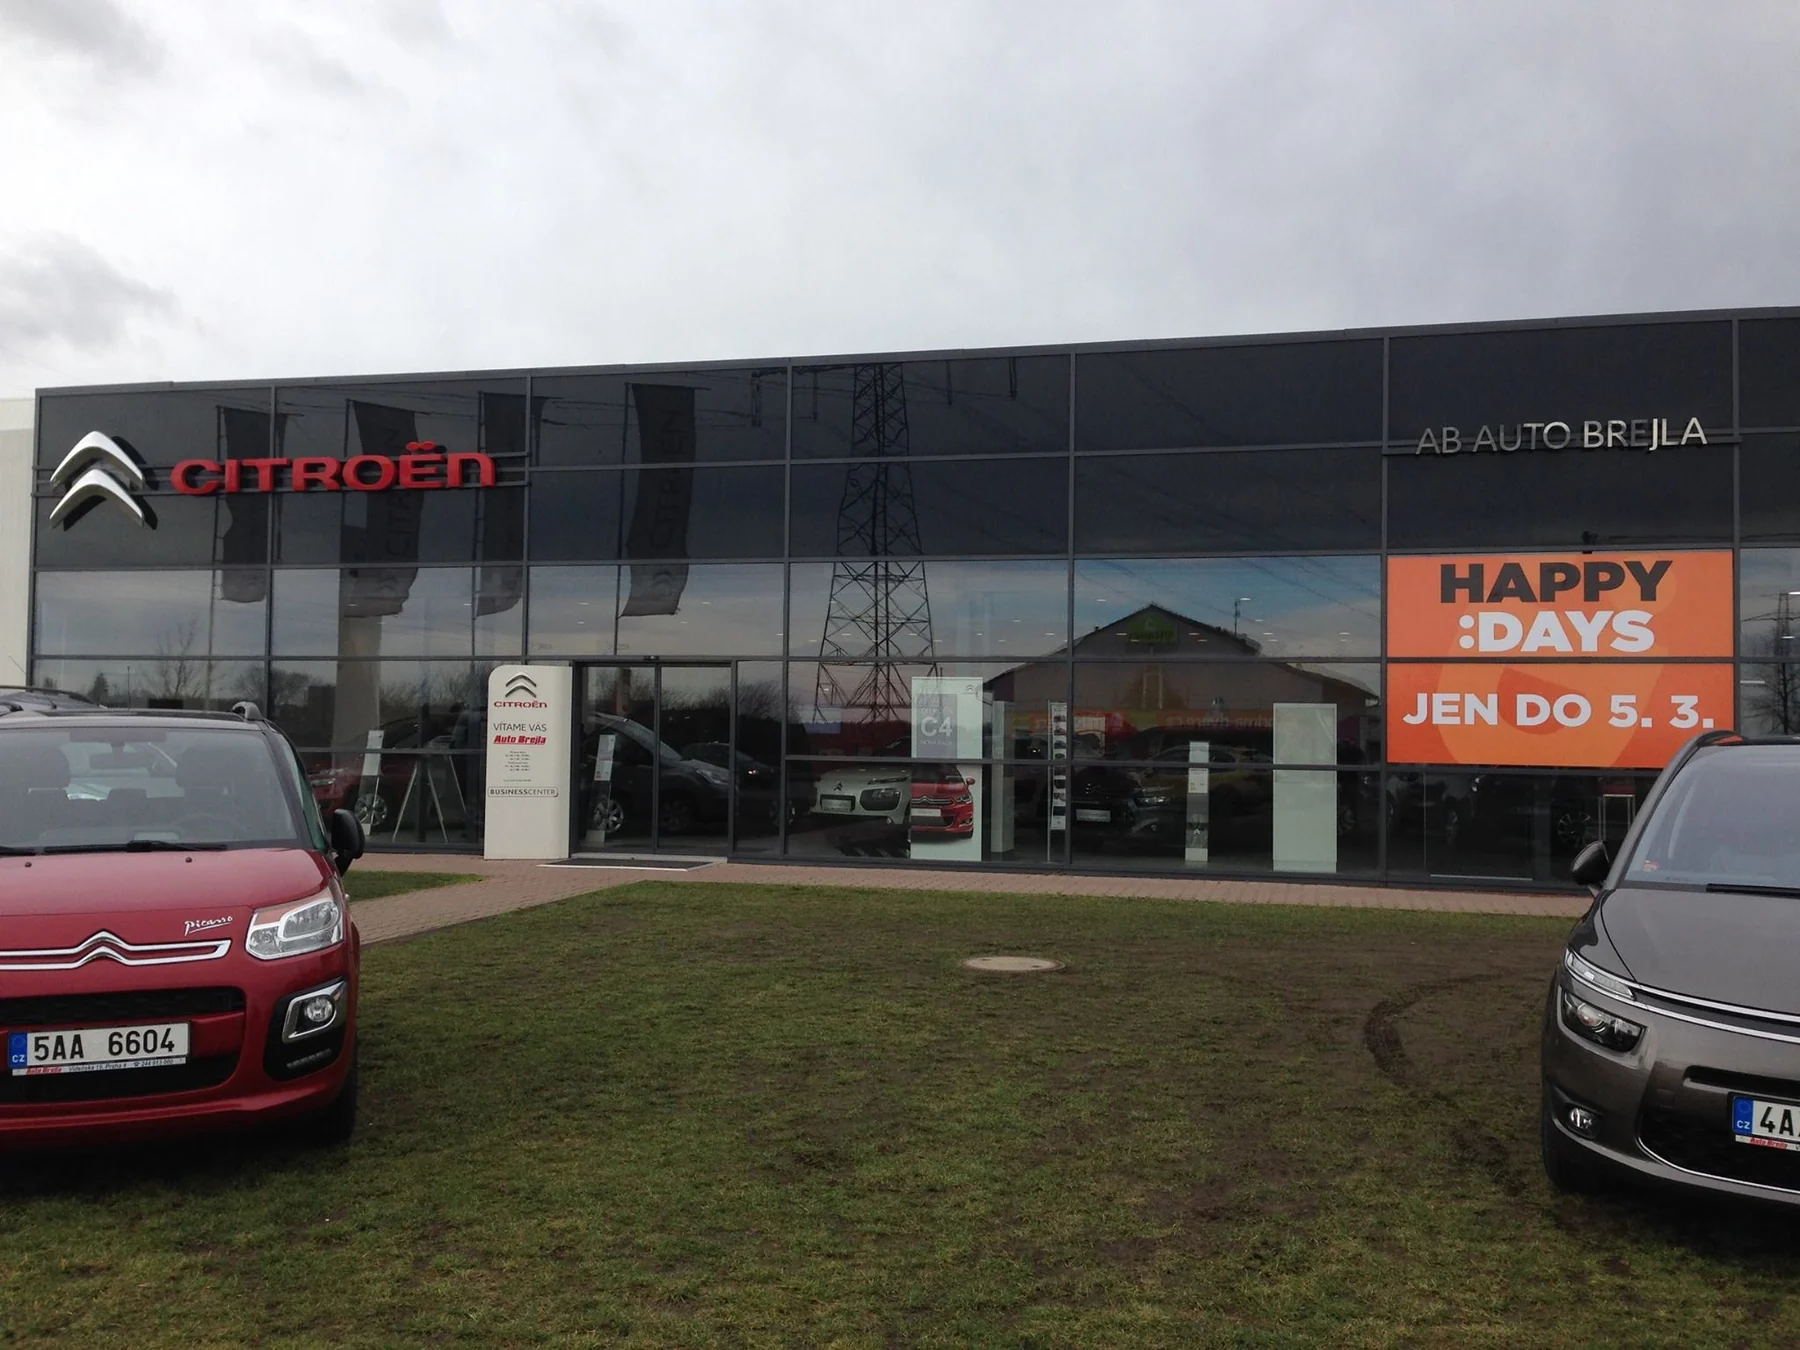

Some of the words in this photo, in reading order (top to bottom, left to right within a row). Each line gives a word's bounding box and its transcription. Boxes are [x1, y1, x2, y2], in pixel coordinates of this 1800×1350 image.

[1415, 426, 1462, 455] AB
[1472, 421, 1571, 452] AUTO
[1583, 417, 1708, 451] BREJLA
[1440, 560, 1673, 604] HAPPY
[1402, 692, 1498, 725] JEN
[1516, 693, 1592, 727] DO
[1608, 694, 1653, 728] 5.
[1669, 695, 1714, 728] 3.
[494, 734, 517, 744] Auto
[518, 735, 547, 745] Brejla
[920, 716, 953, 737] C4
[184, 915, 234, 937] Picasso
[34, 1034, 84, 1061] 5AA
[108, 1028, 175, 1056] 6604
[12, 1054, 26, 1063] CZ
[1736, 1120, 1751, 1130] CZ
[1760, 1106, 1800, 1137] 4A
